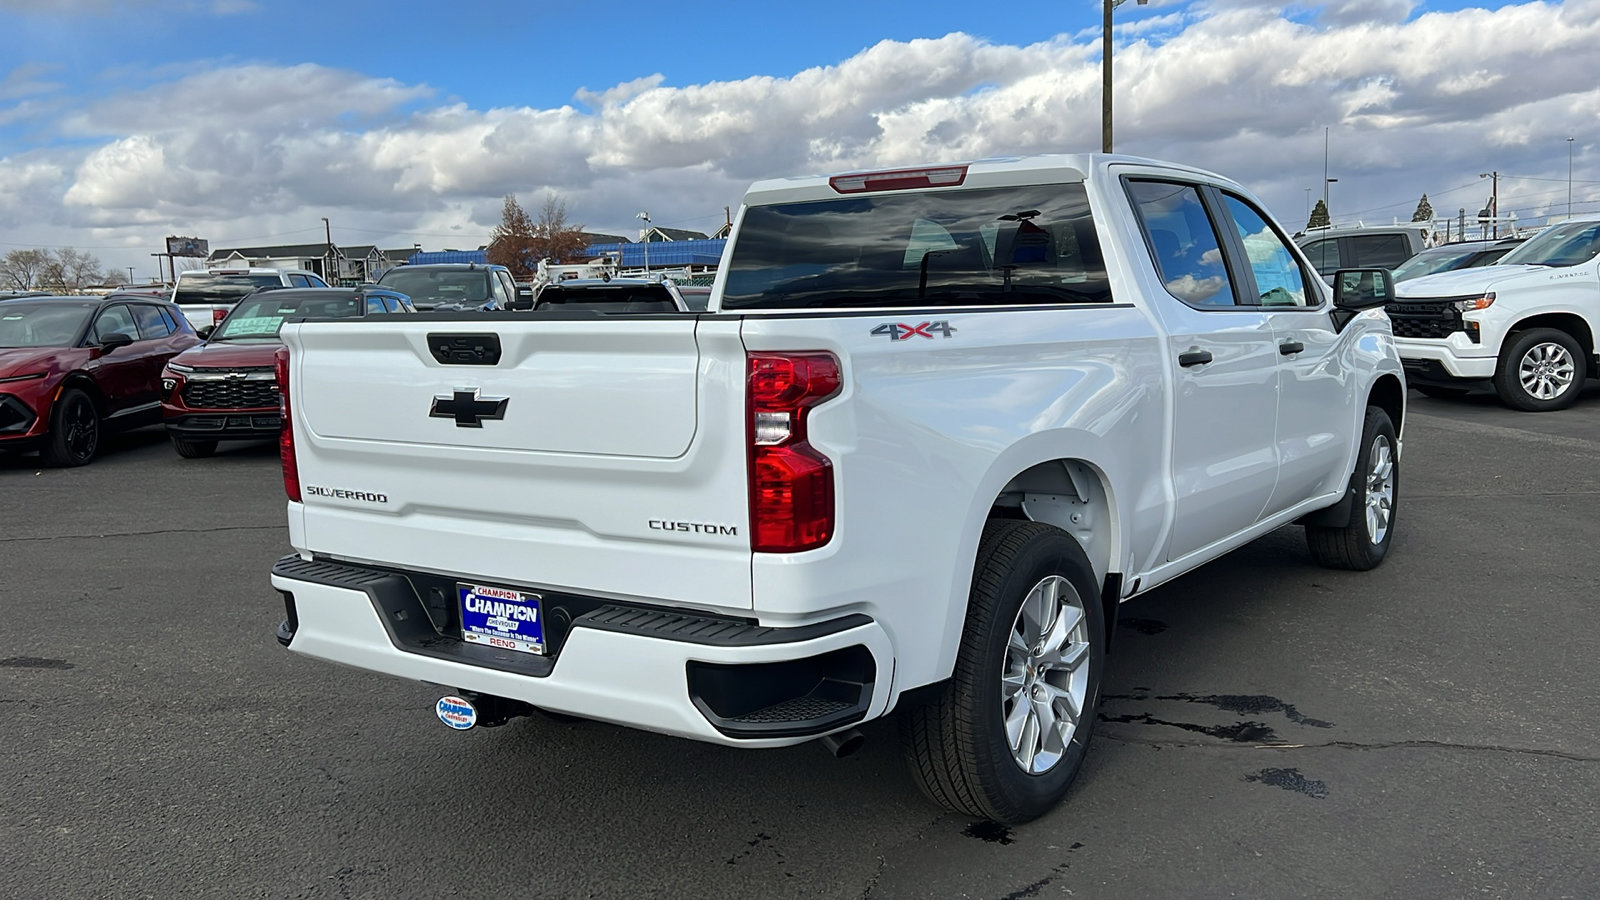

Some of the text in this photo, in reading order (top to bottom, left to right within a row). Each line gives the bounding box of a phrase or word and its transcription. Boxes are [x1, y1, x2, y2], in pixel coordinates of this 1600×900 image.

[306, 485, 389, 503] SILVERADO
[648, 520, 738, 536] CUSTOM
[477, 587, 518, 600] CHAMPION
[465, 593, 538, 623] CHAMPION
[488, 617, 518, 629] CHEVROLET
[489, 637, 517, 649] RENO
